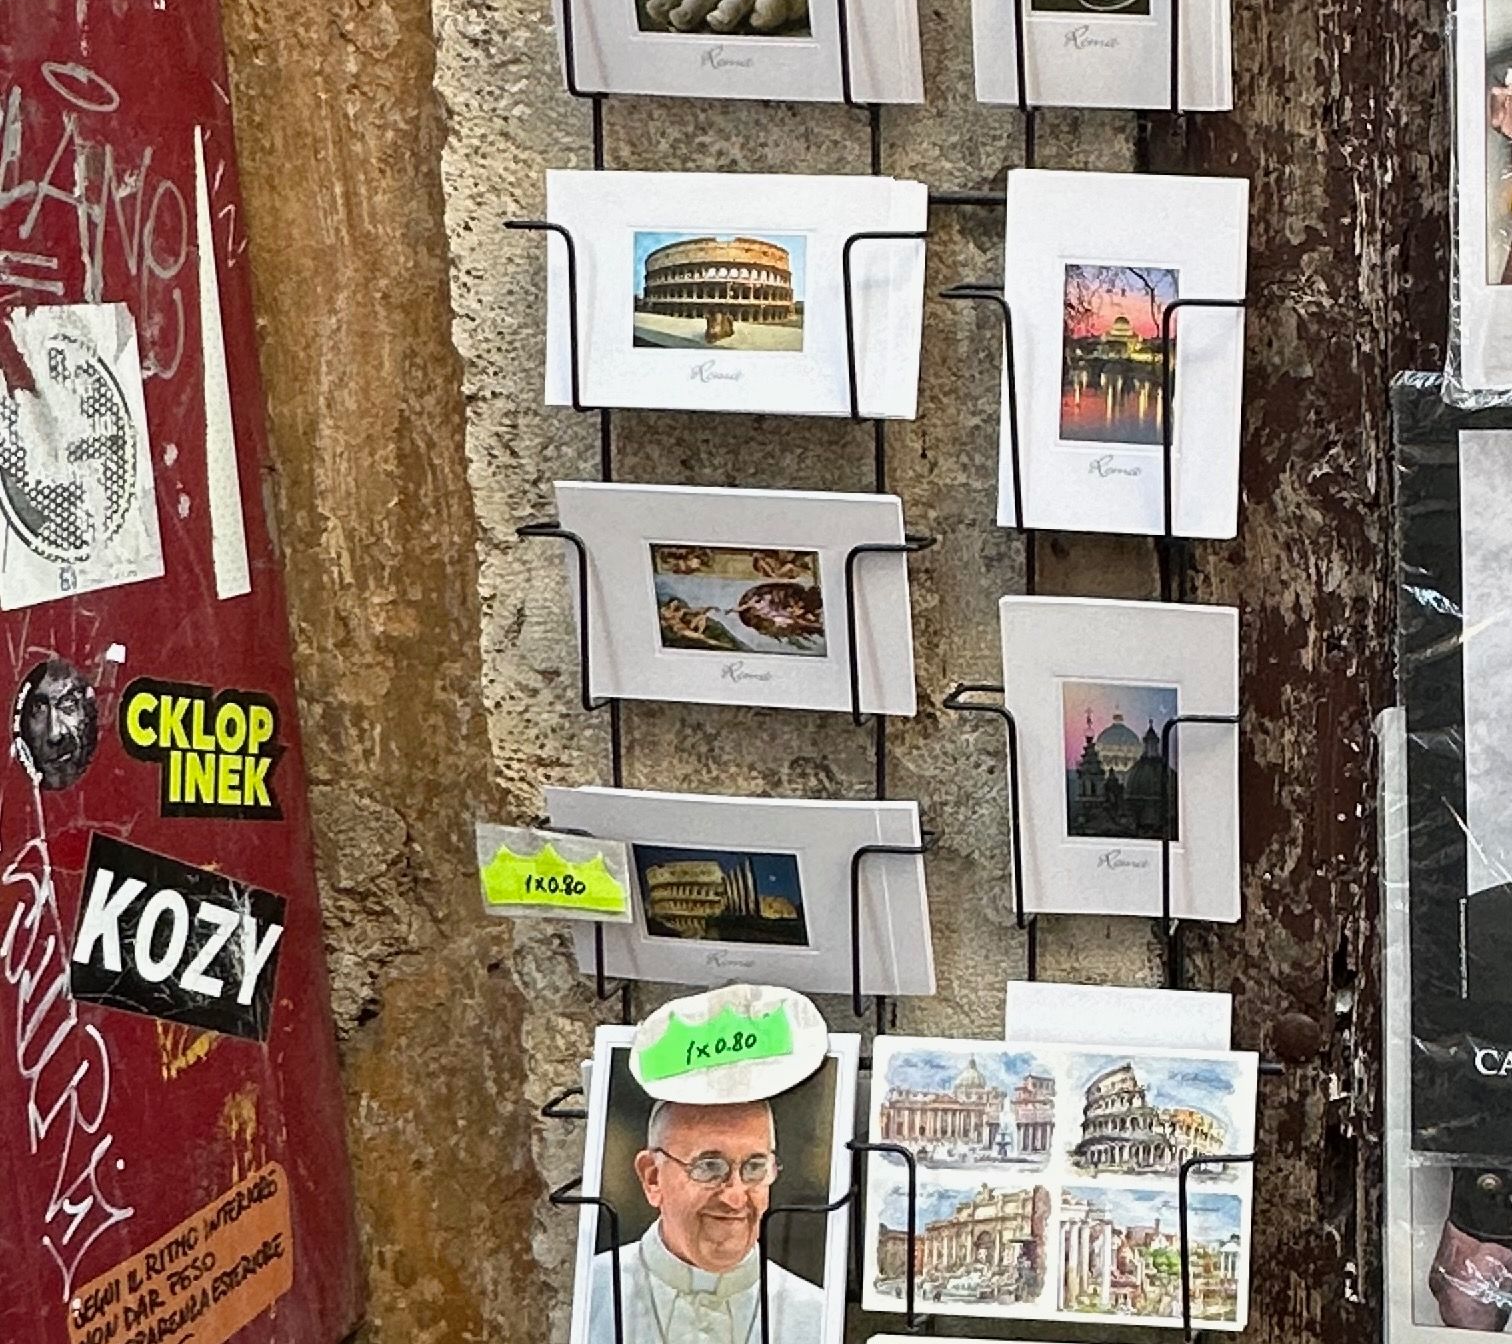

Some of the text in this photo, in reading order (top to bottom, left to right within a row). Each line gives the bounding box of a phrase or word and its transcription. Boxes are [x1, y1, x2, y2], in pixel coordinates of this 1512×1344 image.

[1063, 25, 1120, 51] Roma
[701, 45, 755, 70] Roma
[690, 360, 743, 384] Roma
[1089, 454, 1142, 477] Roma
[721, 660, 774, 684] Roma
[126, 691, 274, 755] CKLOP
[168, 749, 272, 807] INEK
[1097, 849, 1150, 871] Roma
[72, 866, 285, 1006] KOZY
[123, 1288, 166, 1332] DAR
